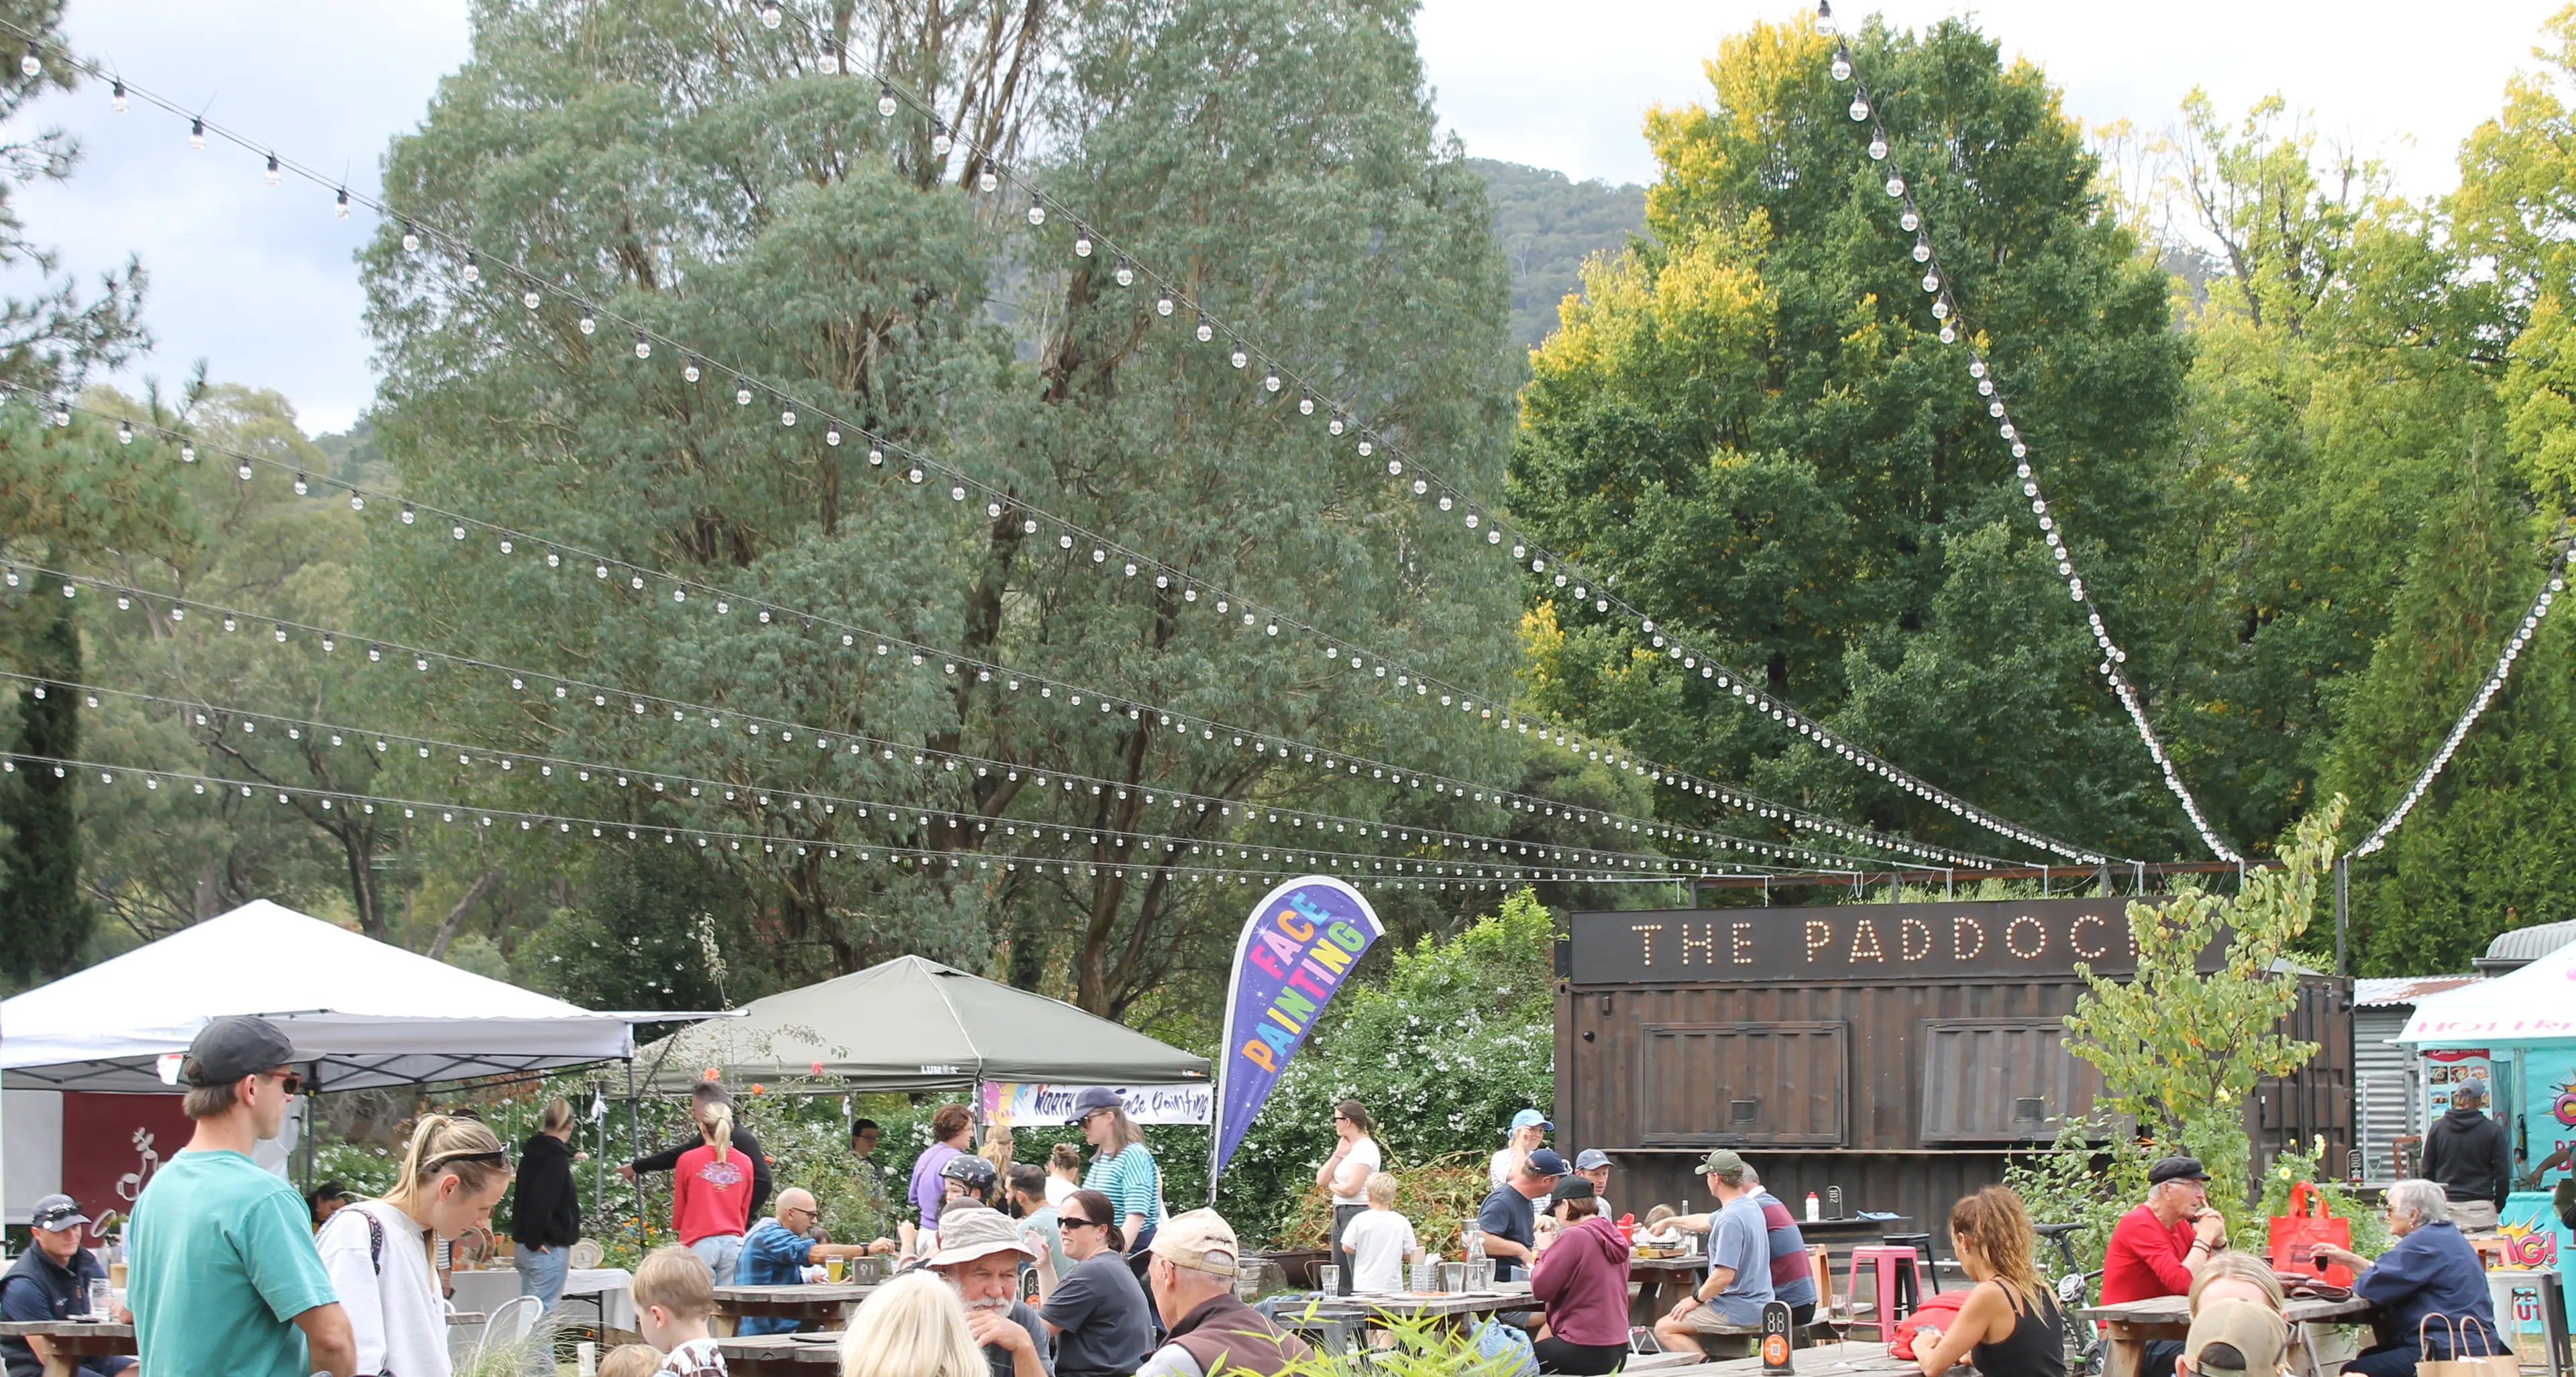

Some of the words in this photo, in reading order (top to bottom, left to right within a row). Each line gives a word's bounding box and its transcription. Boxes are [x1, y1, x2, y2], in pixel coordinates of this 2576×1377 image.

[1249, 891, 1332, 980] FACE
[1631, 922, 1753, 966] THE
[1242, 921, 1365, 1073] PAINTING
[2416, 1021, 2503, 1033] HOT
[1152, 1089, 1208, 1121] Painting
[1829, 1190, 1839, 1203] 102
[1768, 1312, 1784, 1333] 88
